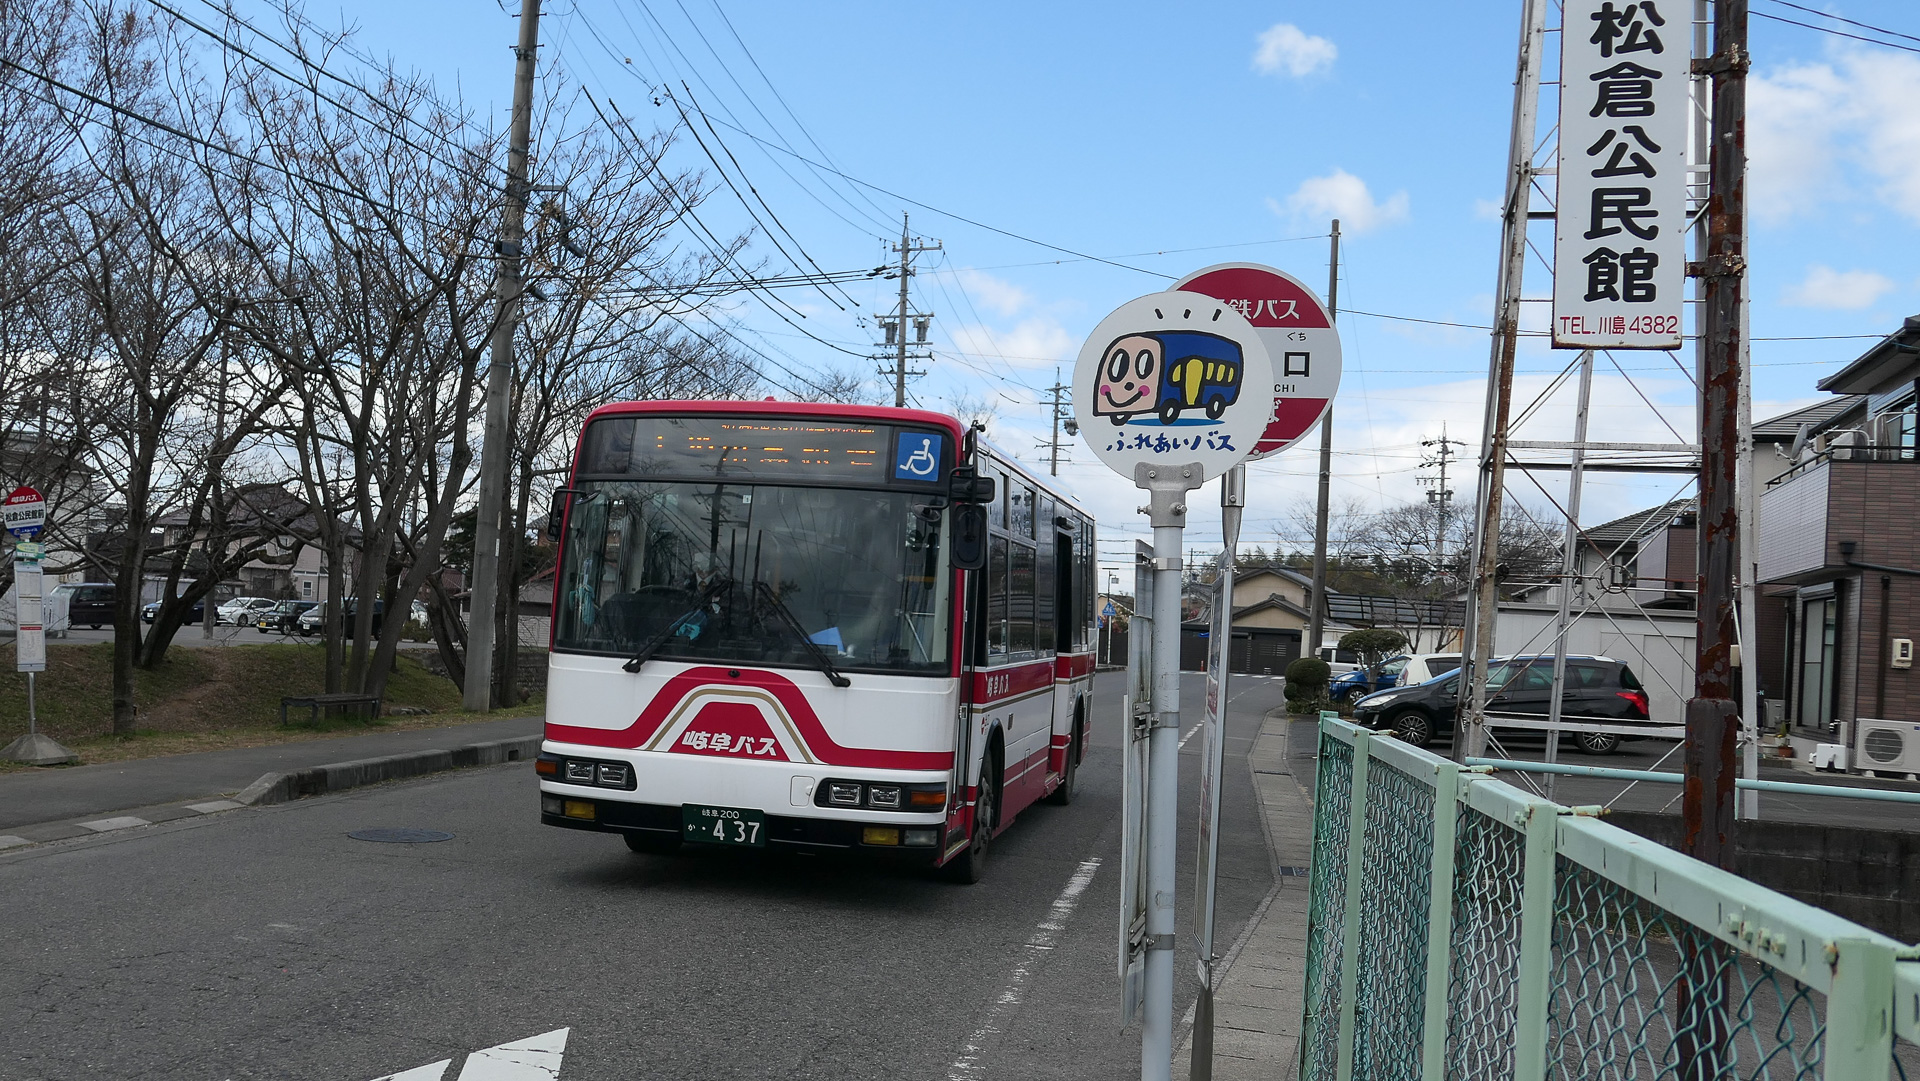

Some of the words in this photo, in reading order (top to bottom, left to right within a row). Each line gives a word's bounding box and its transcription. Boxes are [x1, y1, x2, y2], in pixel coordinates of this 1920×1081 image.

[1582, 0, 1666, 303] 松倉公民館
[1217, 299, 1300, 320] 鉄バス
[1287, 332, 1307, 341] ぐち
[1629, 316, 1678, 335] 4382
[1284, 351, 1310, 377] 口
[1106, 431, 1236, 454] ふれあいバス
[681, 730, 777, 756] 岐阜バス
